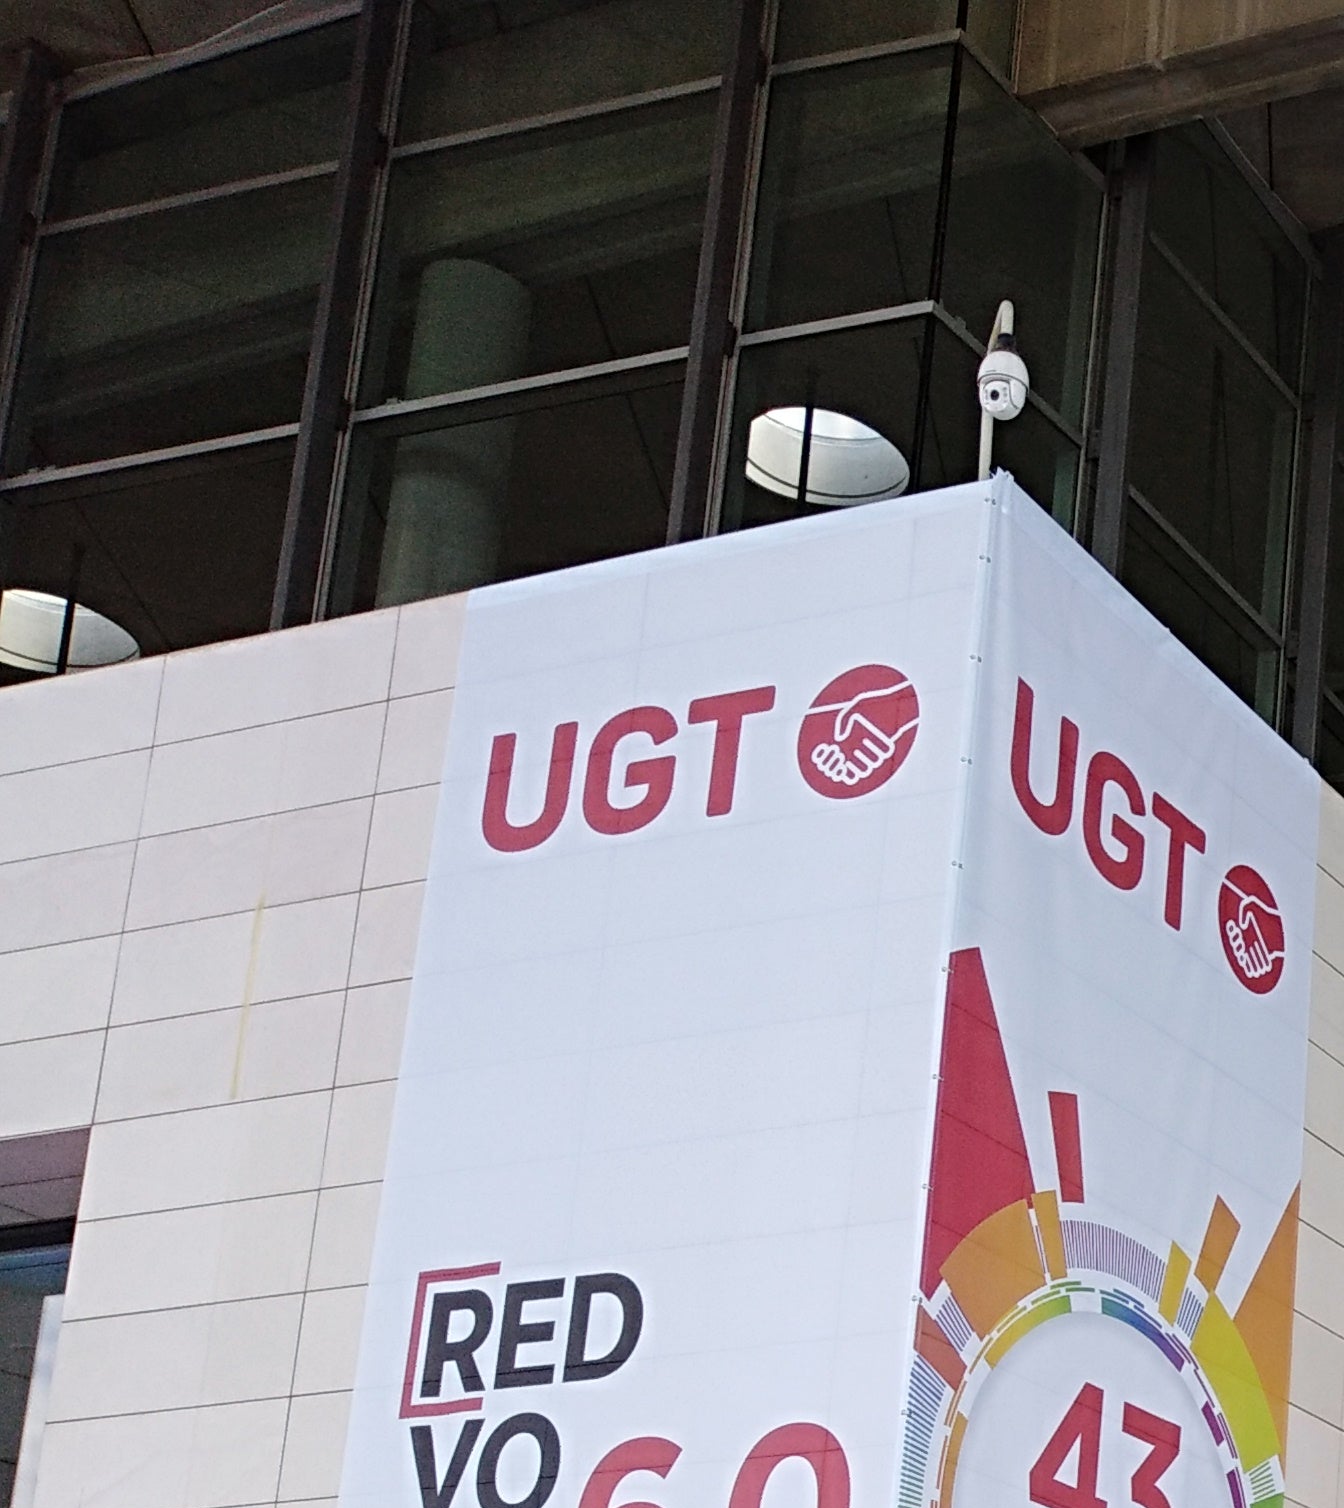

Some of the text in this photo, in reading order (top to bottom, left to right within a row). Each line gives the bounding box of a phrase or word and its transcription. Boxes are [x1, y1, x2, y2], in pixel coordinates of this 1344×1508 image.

[481, 685, 776, 853] UGT
[1010, 676, 1206, 931] UGT
[419, 1272, 644, 1398] RED
